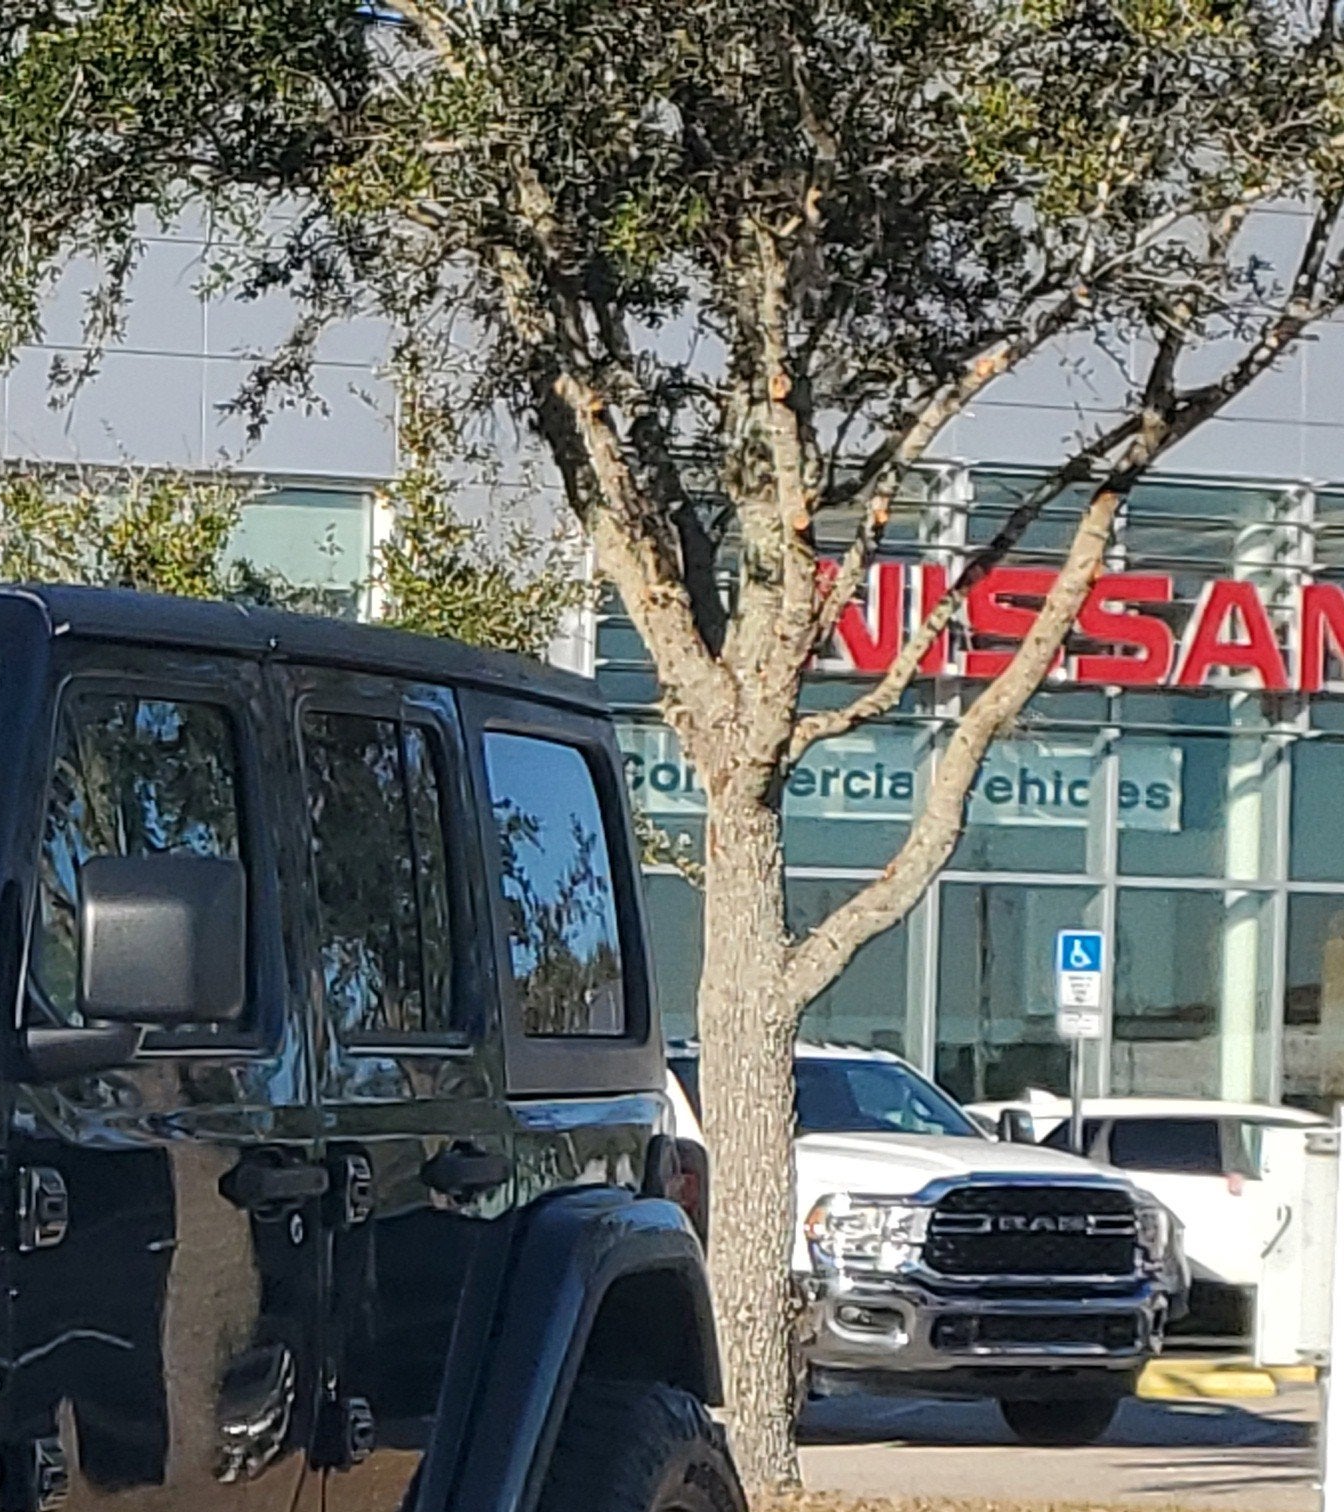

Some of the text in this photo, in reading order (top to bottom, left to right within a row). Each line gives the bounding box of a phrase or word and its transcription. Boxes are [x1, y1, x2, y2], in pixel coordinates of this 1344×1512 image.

[623, 752, 1172, 811] Coercia ehices
[997, 1213, 1086, 1232] RAM
